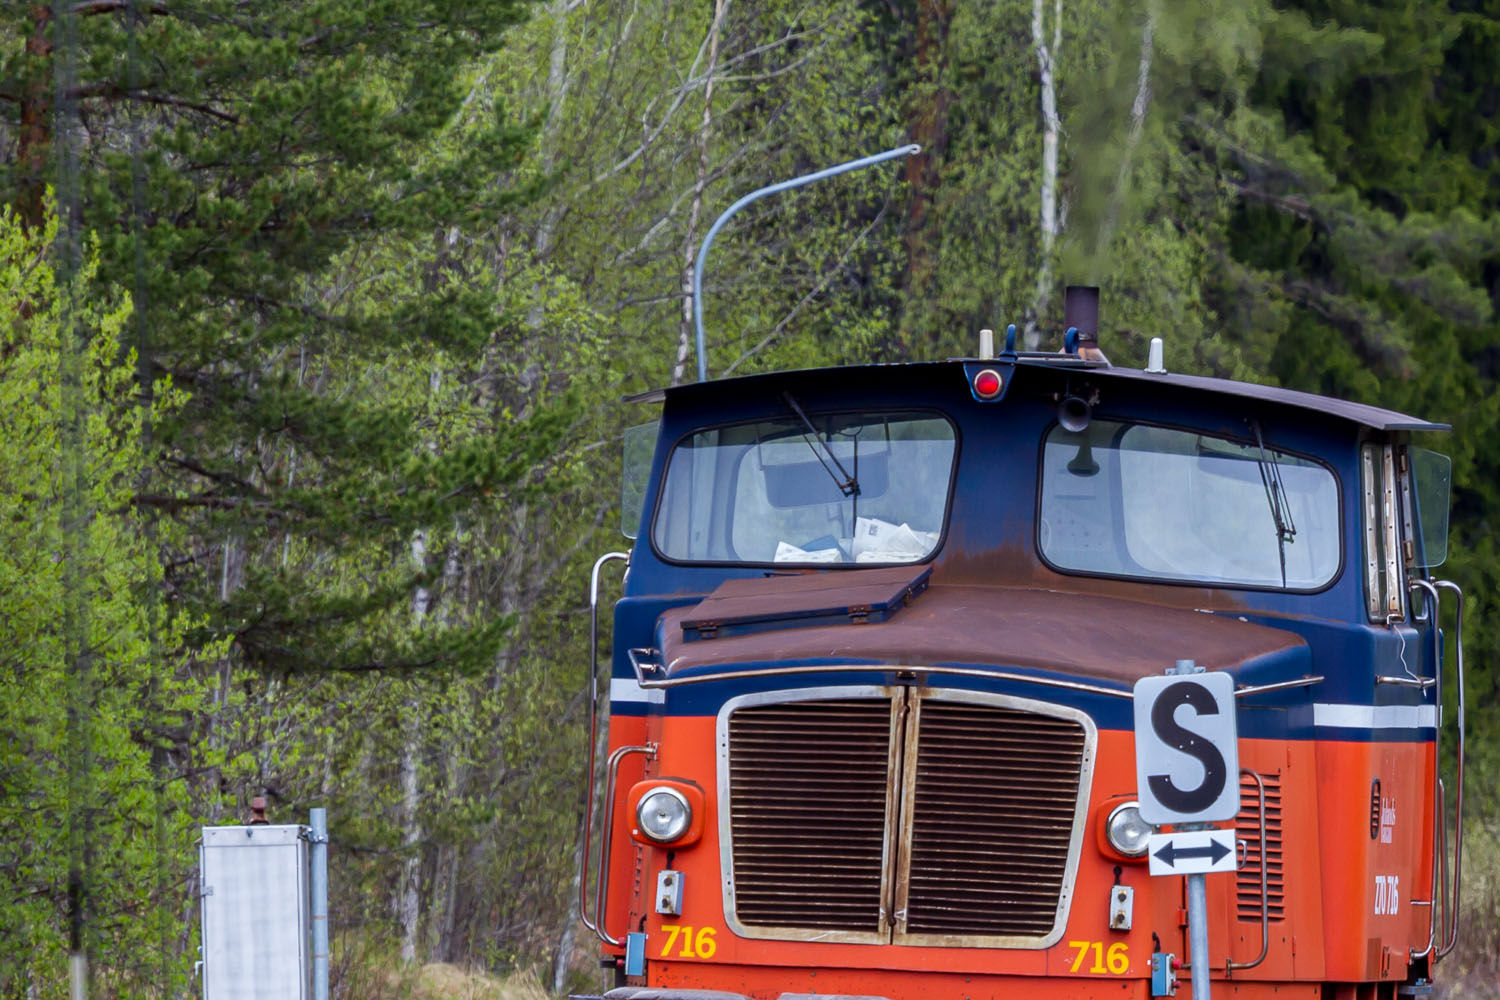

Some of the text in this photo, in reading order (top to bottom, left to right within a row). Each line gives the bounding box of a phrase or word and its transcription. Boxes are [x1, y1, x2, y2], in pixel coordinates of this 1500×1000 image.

[1148, 682, 1227, 813] S
[1387, 874, 1399, 915] 716
[661, 926, 717, 959] 716
[1069, 941, 1129, 975] 716
